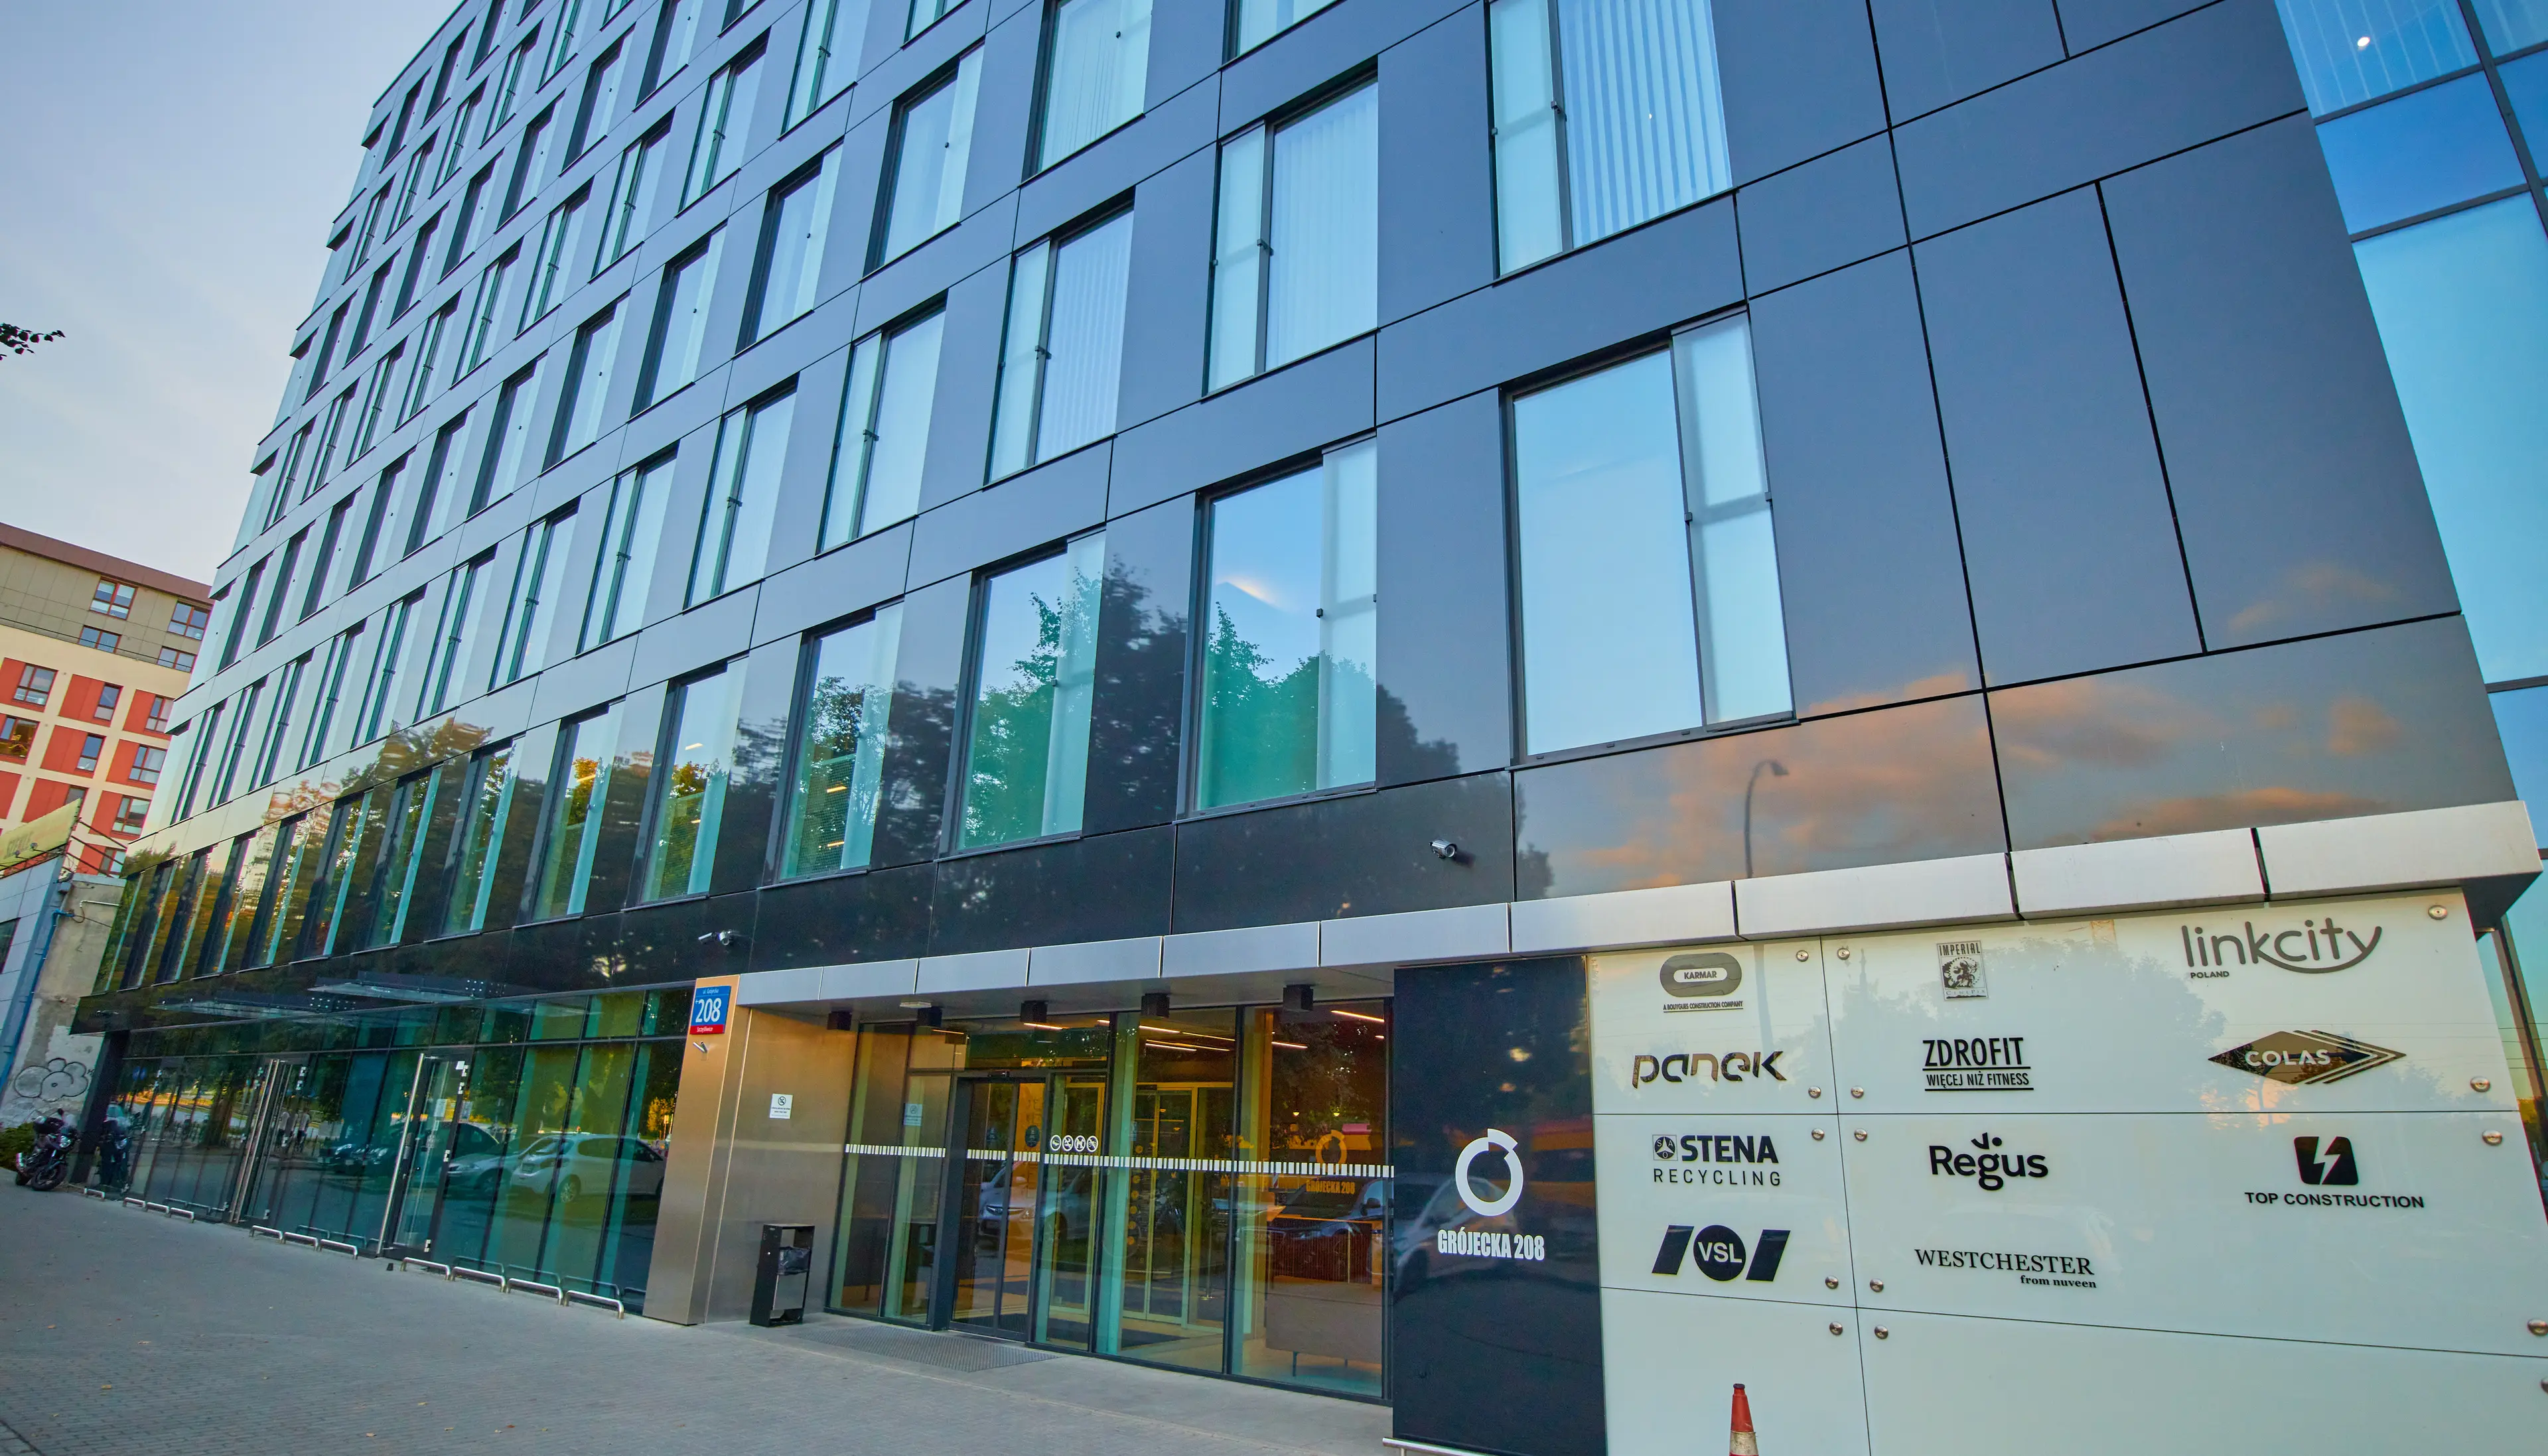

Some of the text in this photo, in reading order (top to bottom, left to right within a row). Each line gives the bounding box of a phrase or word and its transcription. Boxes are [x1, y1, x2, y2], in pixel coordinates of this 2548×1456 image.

[1939, 943, 1980, 956] IMPERIAL
[2181, 917, 2383, 974] linkcity
[1684, 970, 1717, 979] KARMAR
[2190, 970, 2230, 979] POLAND
[695, 998, 722, 1023] 208
[1922, 1037, 2024, 1067] ZDROFIT
[2245, 1049, 2331, 1067] COLAS
[1632, 1051, 1787, 1089] panek
[1926, 1070, 2030, 1089] WIĘCEJ NIŻ FITNESS
[1680, 1134, 1780, 1164] STENA
[1929, 1132, 2049, 1191] Regus
[1654, 1168, 1781, 1187] RECYCLING
[2244, 1192, 2425, 1209] TOP CONSTRUCTION
[1437, 1226, 1545, 1260] GRÓJECKA 208
[1697, 1241, 1742, 1263] VSL
[1914, 1248, 2095, 1276] WESTCHESTER
[2020, 1274, 2097, 1288] from nuveen
